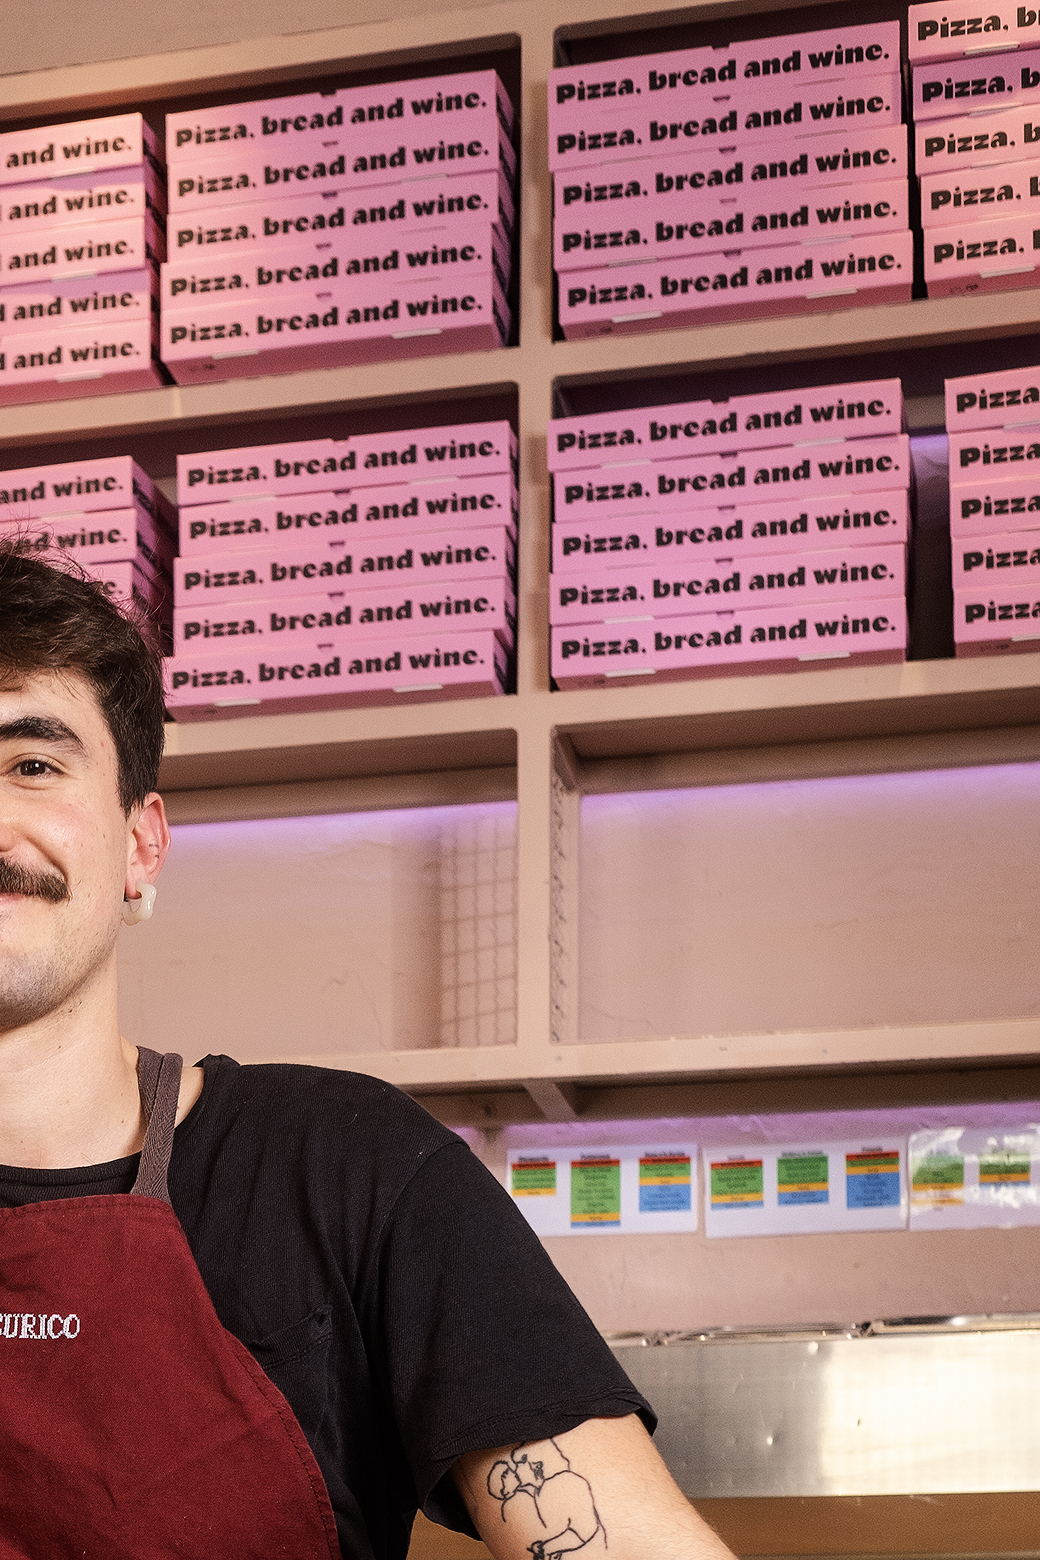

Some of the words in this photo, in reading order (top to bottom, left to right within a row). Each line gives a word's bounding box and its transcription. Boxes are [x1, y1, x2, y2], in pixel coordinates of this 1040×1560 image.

[649, 59, 736, 91] bread
[744, 50, 801, 78] and
[808, 44, 889, 69] wine.
[262, 106, 343, 135] bread
[351, 98, 404, 124] and
[411, 92, 486, 115] wine.
[650, 110, 737, 142] bread
[745, 102, 802, 129] and
[809, 96, 890, 120] wine.
[7, 144, 54, 168] and
[63, 138, 131, 158] wine.
[264, 155, 345, 185] bread
[353, 146, 406, 173] and
[413, 141, 489, 164] wine.
[656, 162, 743, 193] bread
[751, 154, 808, 181] and
[815, 148, 896, 172] wine.
[9, 196, 56, 220] and
[66, 191, 133, 211] wine.
[264, 207, 345, 236] bread
[352, 199, 405, 225] and
[413, 194, 488, 217] wine.
[656, 213, 744, 242] bread
[751, 206, 809, 232] and
[816, 201, 897, 224] wine.
[9, 246, 56, 269] and
[65, 241, 133, 261] wine.
[257, 258, 338, 285] bread
[346, 250, 399, 275] and
[406, 245, 482, 267] wine.
[661, 266, 748, 296] bread
[756, 259, 813, 285] and
[821, 254, 901, 277] wine.
[14, 297, 61, 320] and
[70, 293, 139, 312] wine.
[257, 307, 338, 334] bread
[346, 300, 399, 324] and
[407, 295, 482, 317] wine.
[14, 347, 62, 369] and
[71, 343, 139, 362] wine.
[650, 412, 737, 441] bread
[745, 405, 802, 431] and
[810, 399, 890, 422] wine.
[275, 451, 356, 478] bread
[364, 444, 417, 469] and
[424, 440, 500, 462] wine.
[658, 466, 745, 495] bread
[754, 459, 810, 485] and
[818, 455, 899, 477] wine.
[53, 477, 123, 497] wine.
[277, 504, 358, 530] bread
[366, 497, 418, 521] and
[426, 493, 501, 514] wine.
[656, 519, 743, 547] bread
[751, 513, 808, 538] and
[816, 509, 897, 531] wine.
[57, 528, 128, 548] wine.
[271, 555, 352, 581] bread
[360, 549, 413, 573] and
[420, 545, 496, 566] wine.
[653, 572, 740, 598] bread
[749, 566, 805, 590] and
[813, 563, 894, 584] wine.
[270, 606, 351, 631] bread
[359, 600, 412, 623] and
[420, 596, 495, 617] wine.
[655, 625, 742, 651] bread
[750, 619, 807, 643] and
[815, 615, 895, 637] wine.
[259, 657, 340, 682] bread
[348, 652, 401, 675] and
[409, 648, 484, 669] wine.
